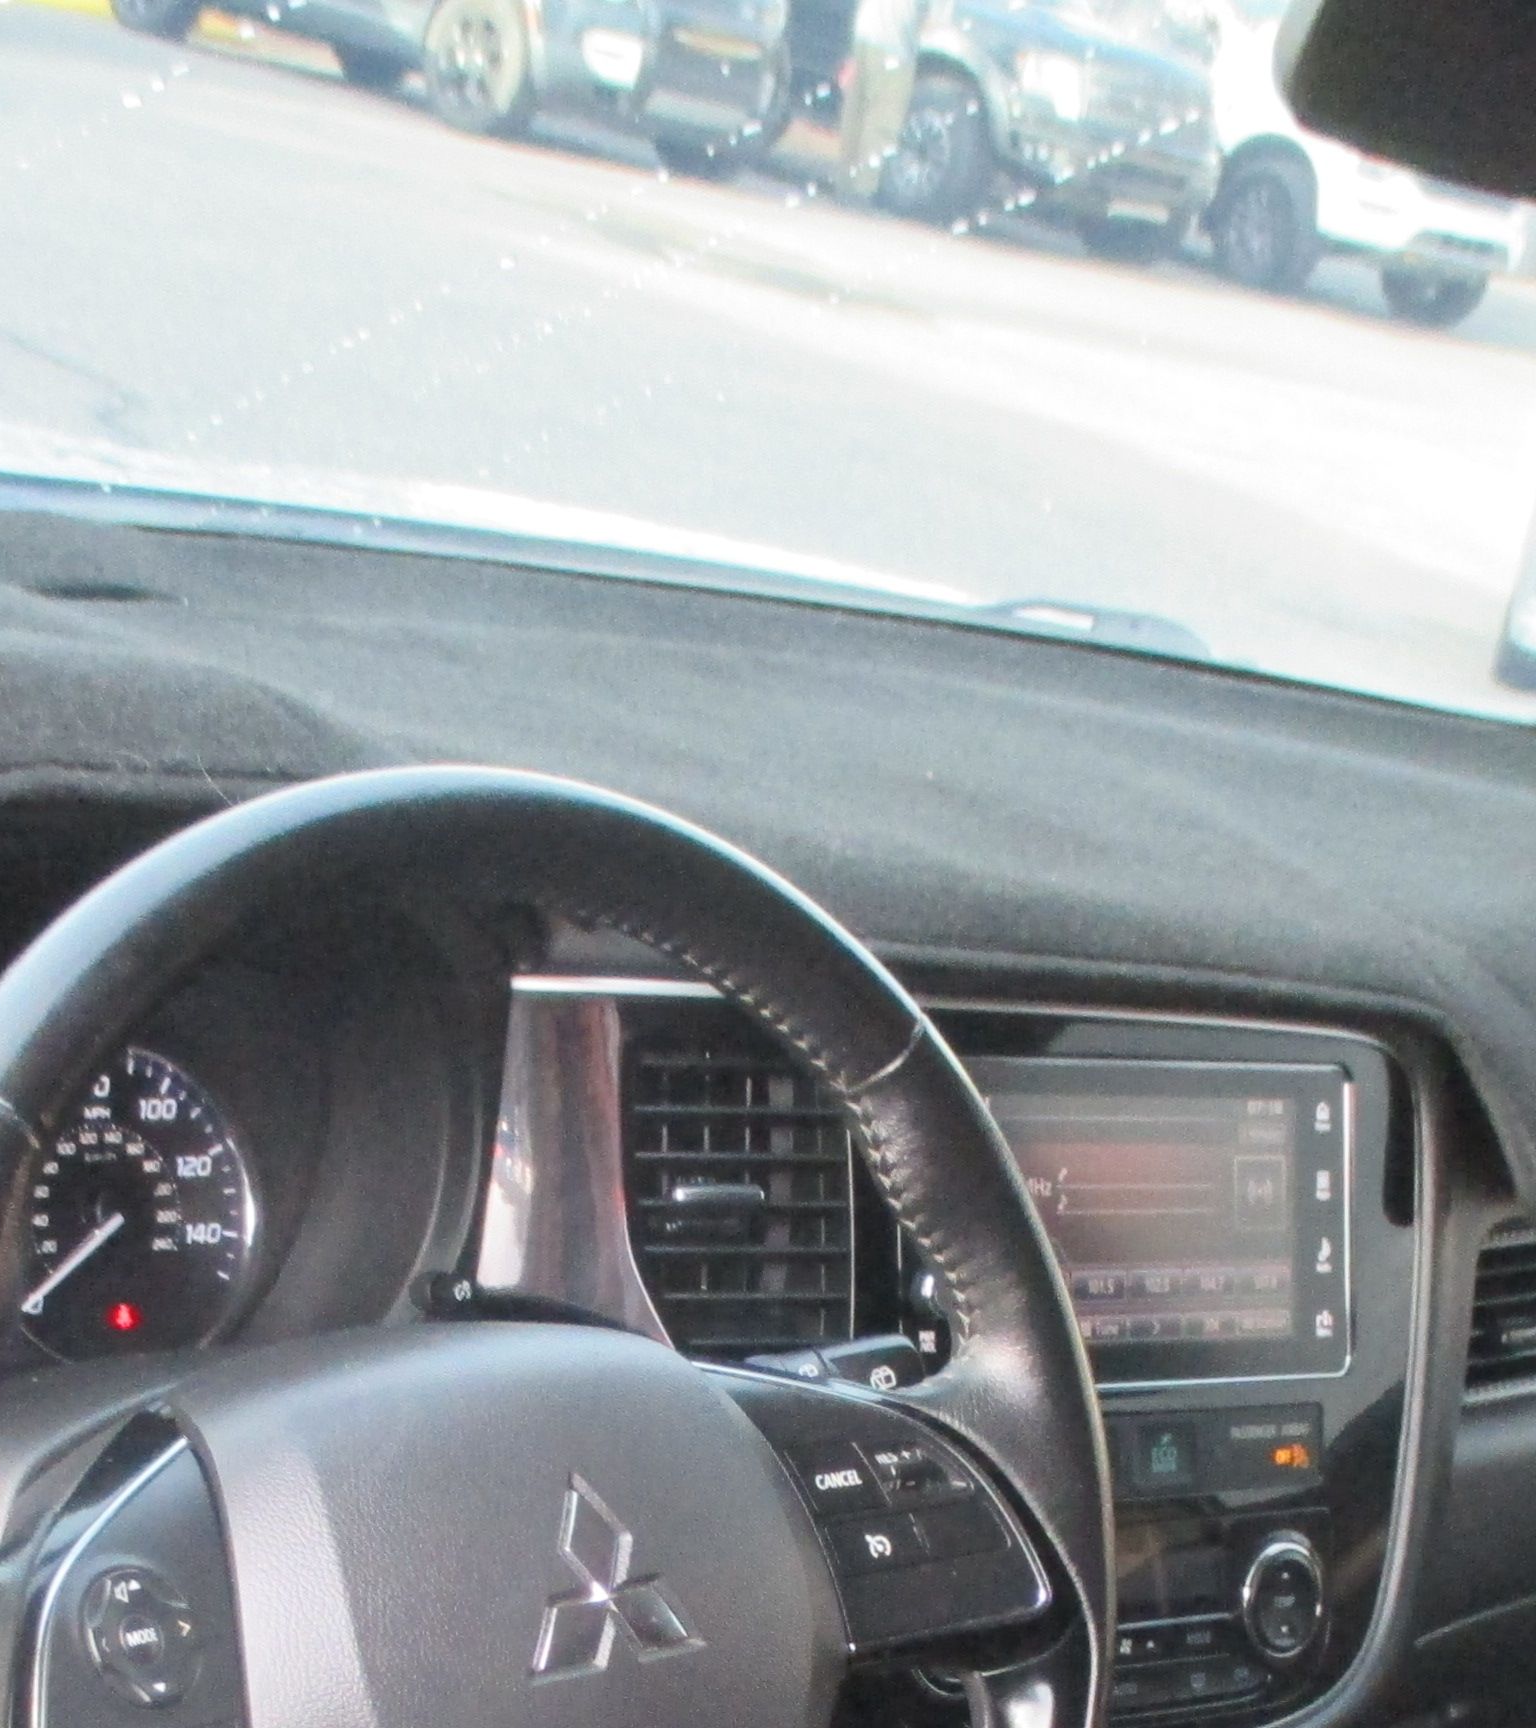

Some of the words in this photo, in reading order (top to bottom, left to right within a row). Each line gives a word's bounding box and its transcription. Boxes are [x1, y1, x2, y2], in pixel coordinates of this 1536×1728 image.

[139, 1099, 178, 1120] 100
[176, 1156, 212, 1177] 120
[186, 1223, 222, 1244] 140
[815, 1469, 863, 1490] CANCEL
[125, 1627, 159, 1648] MODE
